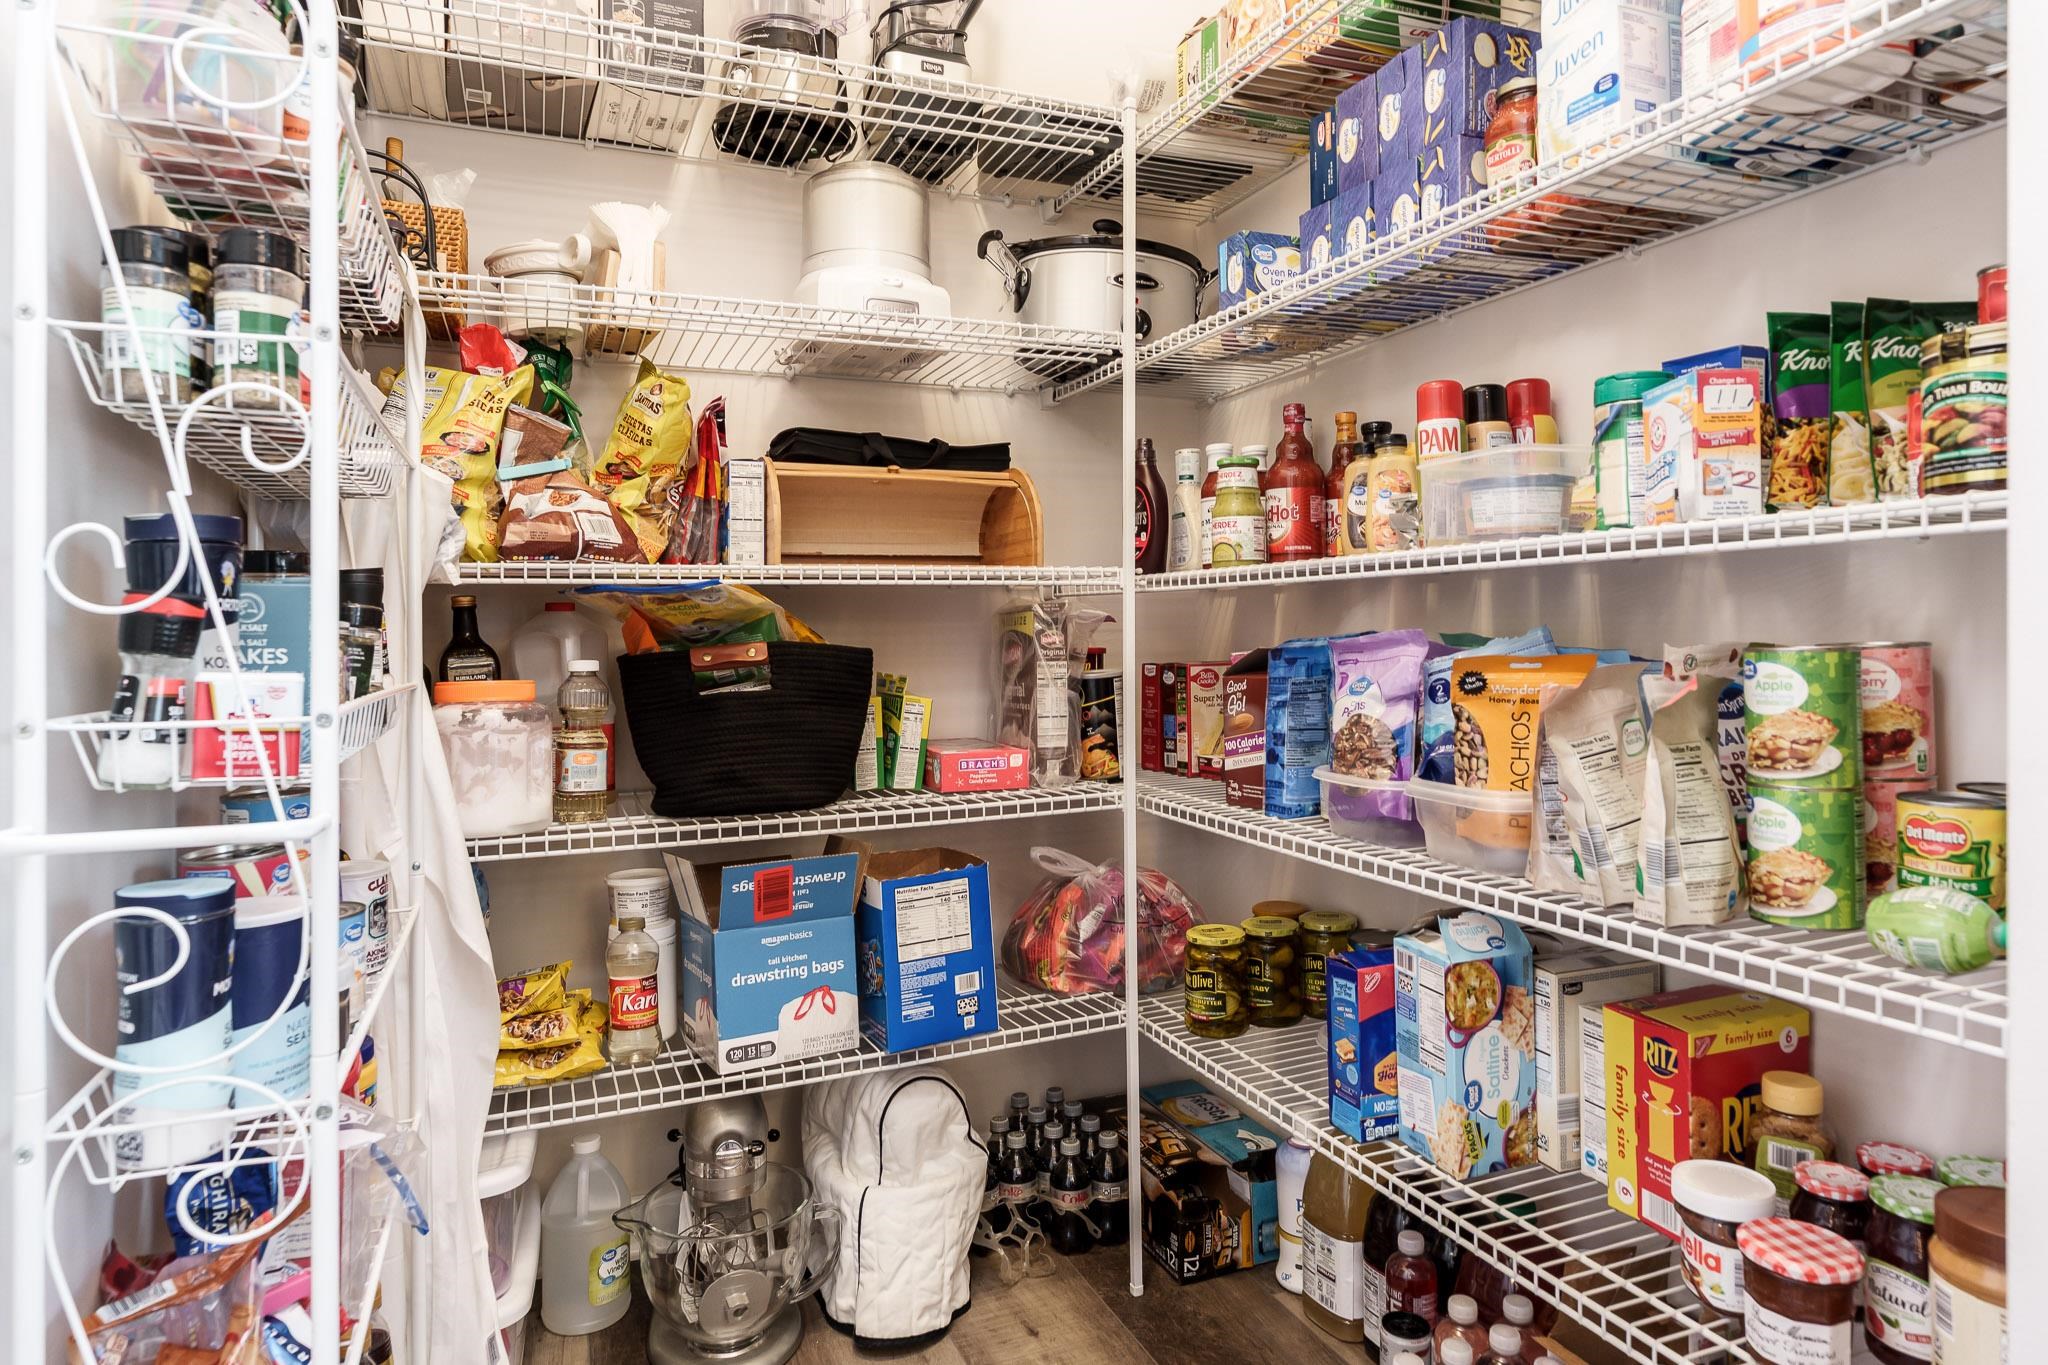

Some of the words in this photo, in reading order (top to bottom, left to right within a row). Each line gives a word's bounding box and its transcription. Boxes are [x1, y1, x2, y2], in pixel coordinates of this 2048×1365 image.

[1549, 30, 1604, 87] Juven
[923, 63, 943, 74] NINJA
[1487, 144, 1524, 167] BERTOLLI
[1262, 266, 1286, 277] Oven
[1871, 336, 1923, 359] Kno
[1709, 377, 1734, 386] Change
[1935, 383, 1966, 400] THAN
[468, 399, 503, 414] SICAS
[634, 392, 662, 415] SANTITAS
[622, 412, 653, 436] RECETAS
[1419, 426, 1459, 455] PAM
[1217, 470, 1243, 479] HERDEZ
[1268, 504, 1299, 521] dHot
[1212, 520, 1238, 530] HERDEZ
[246, 638, 268, 647] SALT
[238, 648, 289, 665] AKES
[455, 674, 487, 682] KIRKLAND
[1464, 681, 1484, 690] Shells
[1465, 676, 1477, 684] No
[1755, 679, 1793, 692] Apple
[1861, 677, 1888, 689] erry
[1226, 679, 1247, 693] Good
[1436, 686, 1445, 696] 2
[1490, 684, 1540, 695] Wonder
[1193, 695, 1215, 703] Super
[1227, 695, 1246, 716] Go!
[1488, 696, 1517, 706] Honey
[1519, 697, 1540, 705] Roas
[1224, 741, 1237, 751] 100
[1236, 734, 1266, 748] Calories
[1752, 815, 1786, 829] Apple
[1906, 825, 1922, 840] Del
[1923, 828, 1967, 845] Monte
[793, 871, 846, 884] drawstr
[1901, 870, 1925, 884] Pear
[1928, 876, 1978, 892] Halves
[957, 893, 968, 901] 140
[366, 945, 386, 959] AKING
[767, 956, 781, 967] tall
[781, 952, 808, 964] kitchen
[731, 964, 808, 987] drawstring
[812, 958, 845, 975] bags
[1192, 972, 1213, 989] Olive
[622, 991, 658, 1012] Karo
[1682, 1008, 1736, 1023] family
[1725, 1031, 1755, 1046] family
[1757, 1028, 1774, 1039] size
[1785, 1029, 1793, 1043] 6
[729, 1050, 743, 1059] 120
[747, 1047, 756, 1057] 13
[1643, 1036, 1679, 1074] RITZ
[1487, 1035, 1501, 1099] Saltine
[1502, 1044, 1510, 1081] Crackers
[1612, 1063, 1629, 1123] family
[1187, 1094, 1233, 1122] FRESCA
[1373, 1101, 1386, 1113] NO
[1462, 1121, 1477, 1154] PACKS
[1616, 1129, 1631, 1159] size
[1680, 1228, 1722, 1274] tella
[1184, 1257, 1200, 1273] 12
